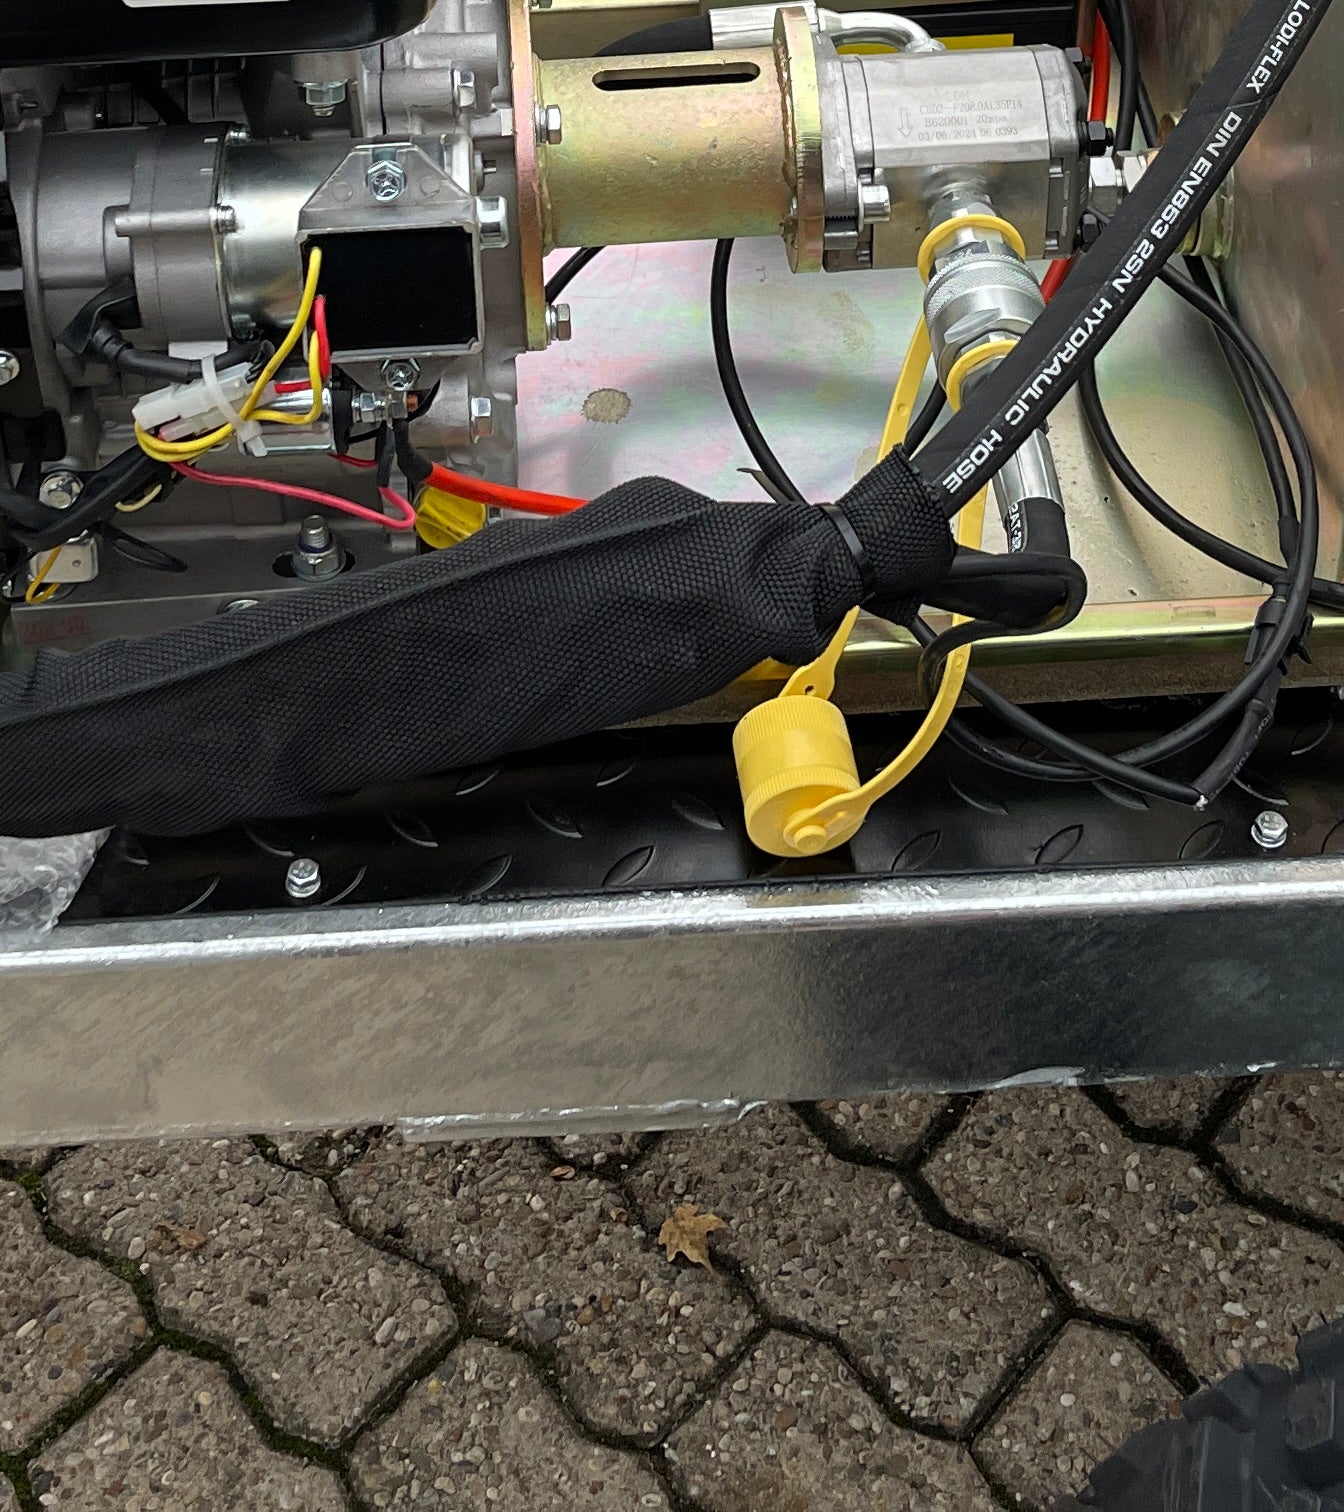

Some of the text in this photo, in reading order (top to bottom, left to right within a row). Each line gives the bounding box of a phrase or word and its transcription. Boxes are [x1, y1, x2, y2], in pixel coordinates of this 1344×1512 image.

[942, 0, 1310, 494] LODI-FLEX DIN EN853 2SN HYDRAULIC HOSE
